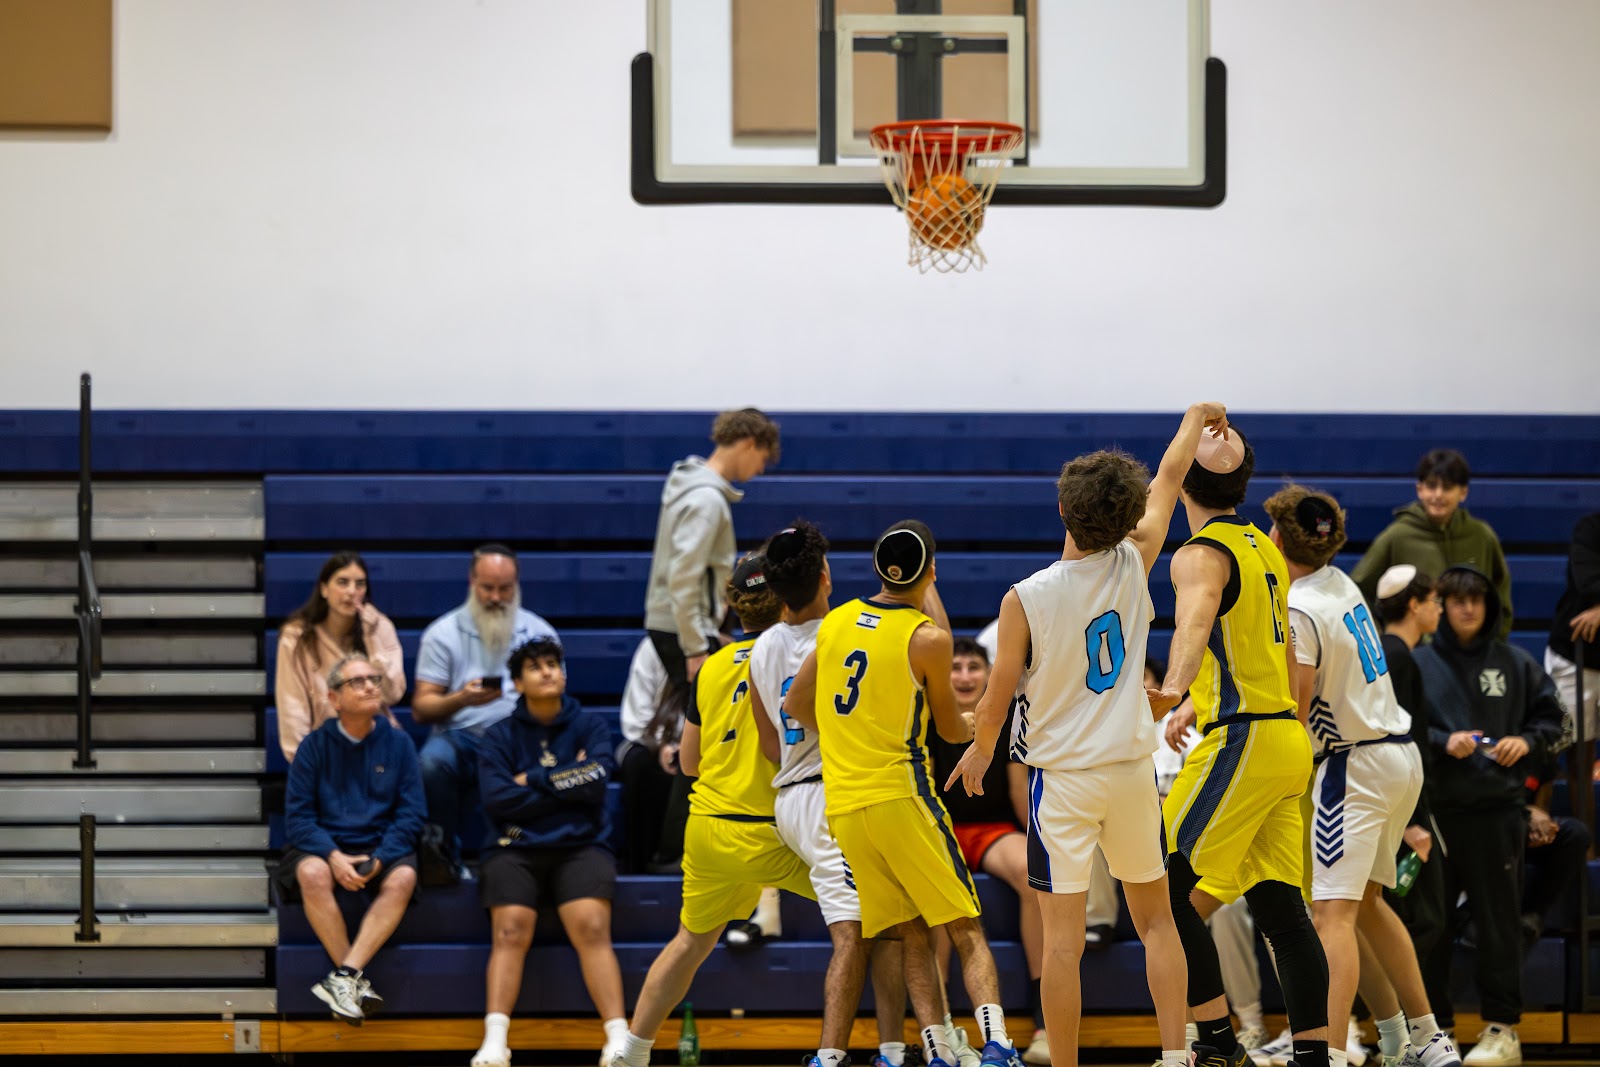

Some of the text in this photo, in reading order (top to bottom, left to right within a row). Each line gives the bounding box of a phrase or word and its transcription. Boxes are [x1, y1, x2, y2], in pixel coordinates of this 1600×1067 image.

[834, 649, 868, 716] 3
[1085, 609, 1126, 695] 0
[1343, 603, 1387, 684] 10
